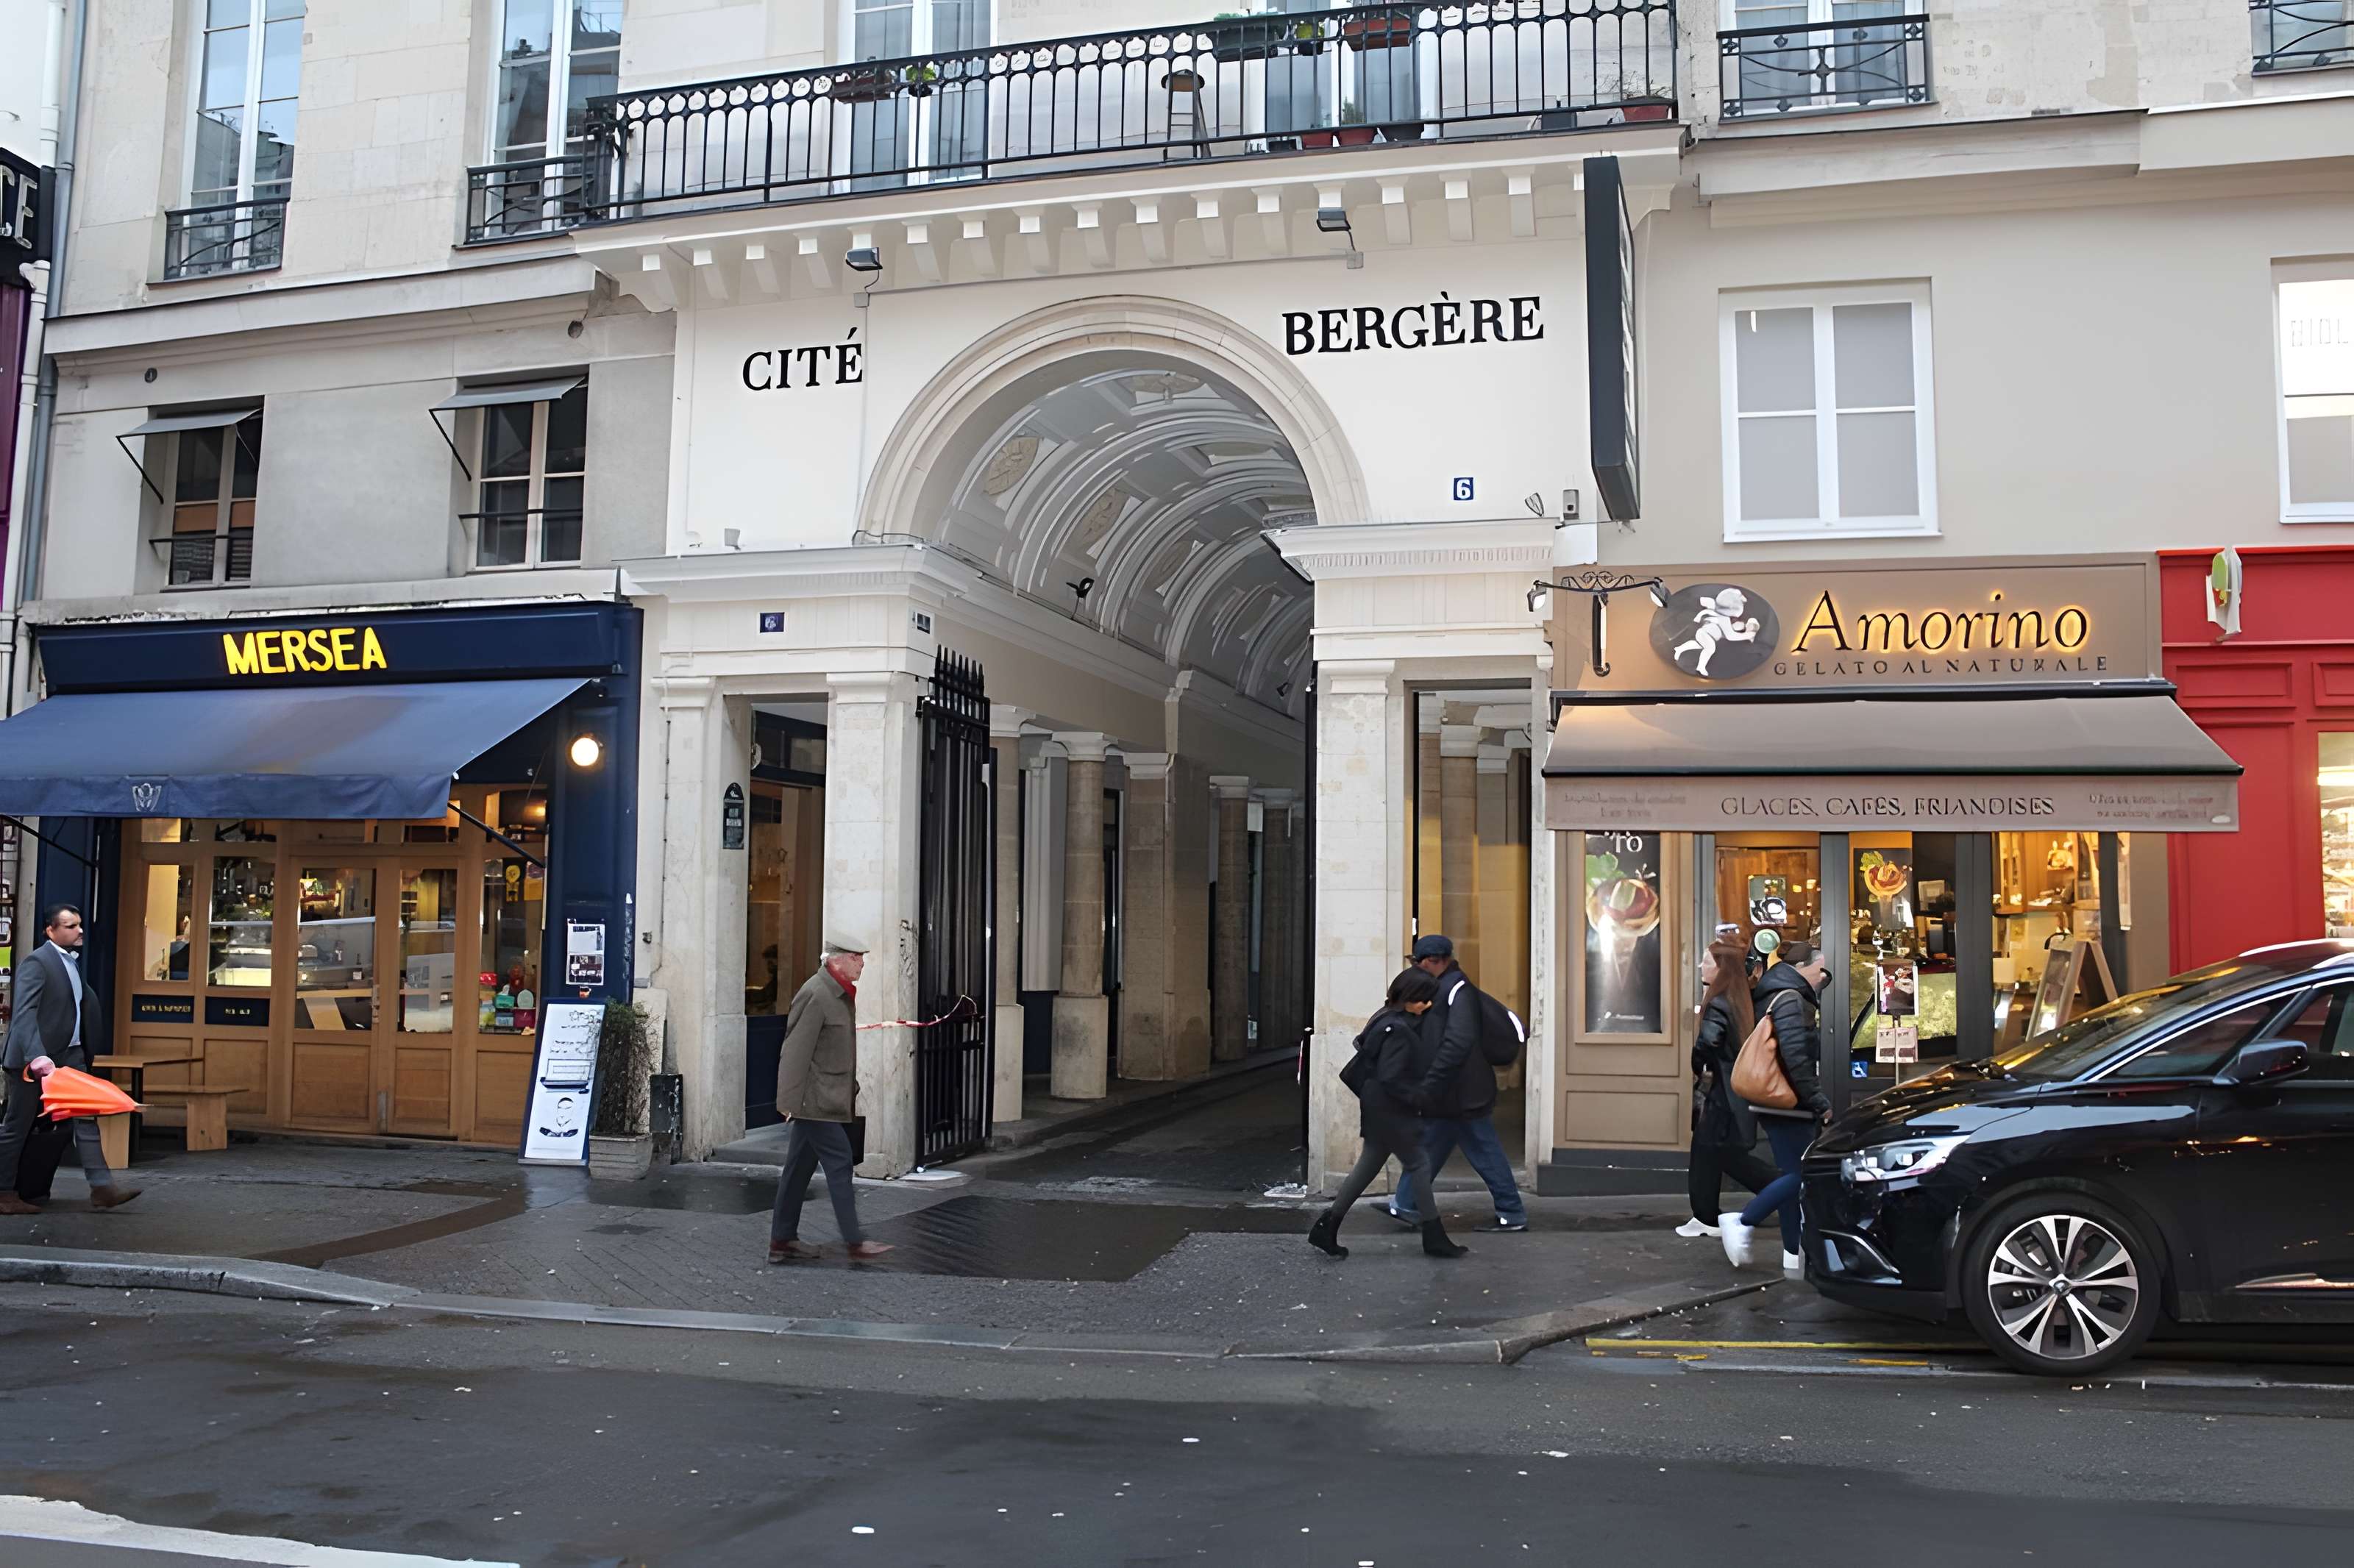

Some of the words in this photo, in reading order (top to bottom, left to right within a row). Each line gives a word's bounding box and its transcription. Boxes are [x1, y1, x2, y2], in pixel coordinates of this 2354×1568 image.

[742, 327, 863, 391] CITÉ
[1281, 291, 1544, 356] BERGÈRE
[1457, 479, 1471, 499] 6
[1791, 590, 2087, 652] Amorino
[222, 627, 388, 674] MERSEA
[1774, 660, 1888, 676] GELATO
[1902, 659, 1932, 674] AL
[1945, 656, 2108, 674] NATURALE
